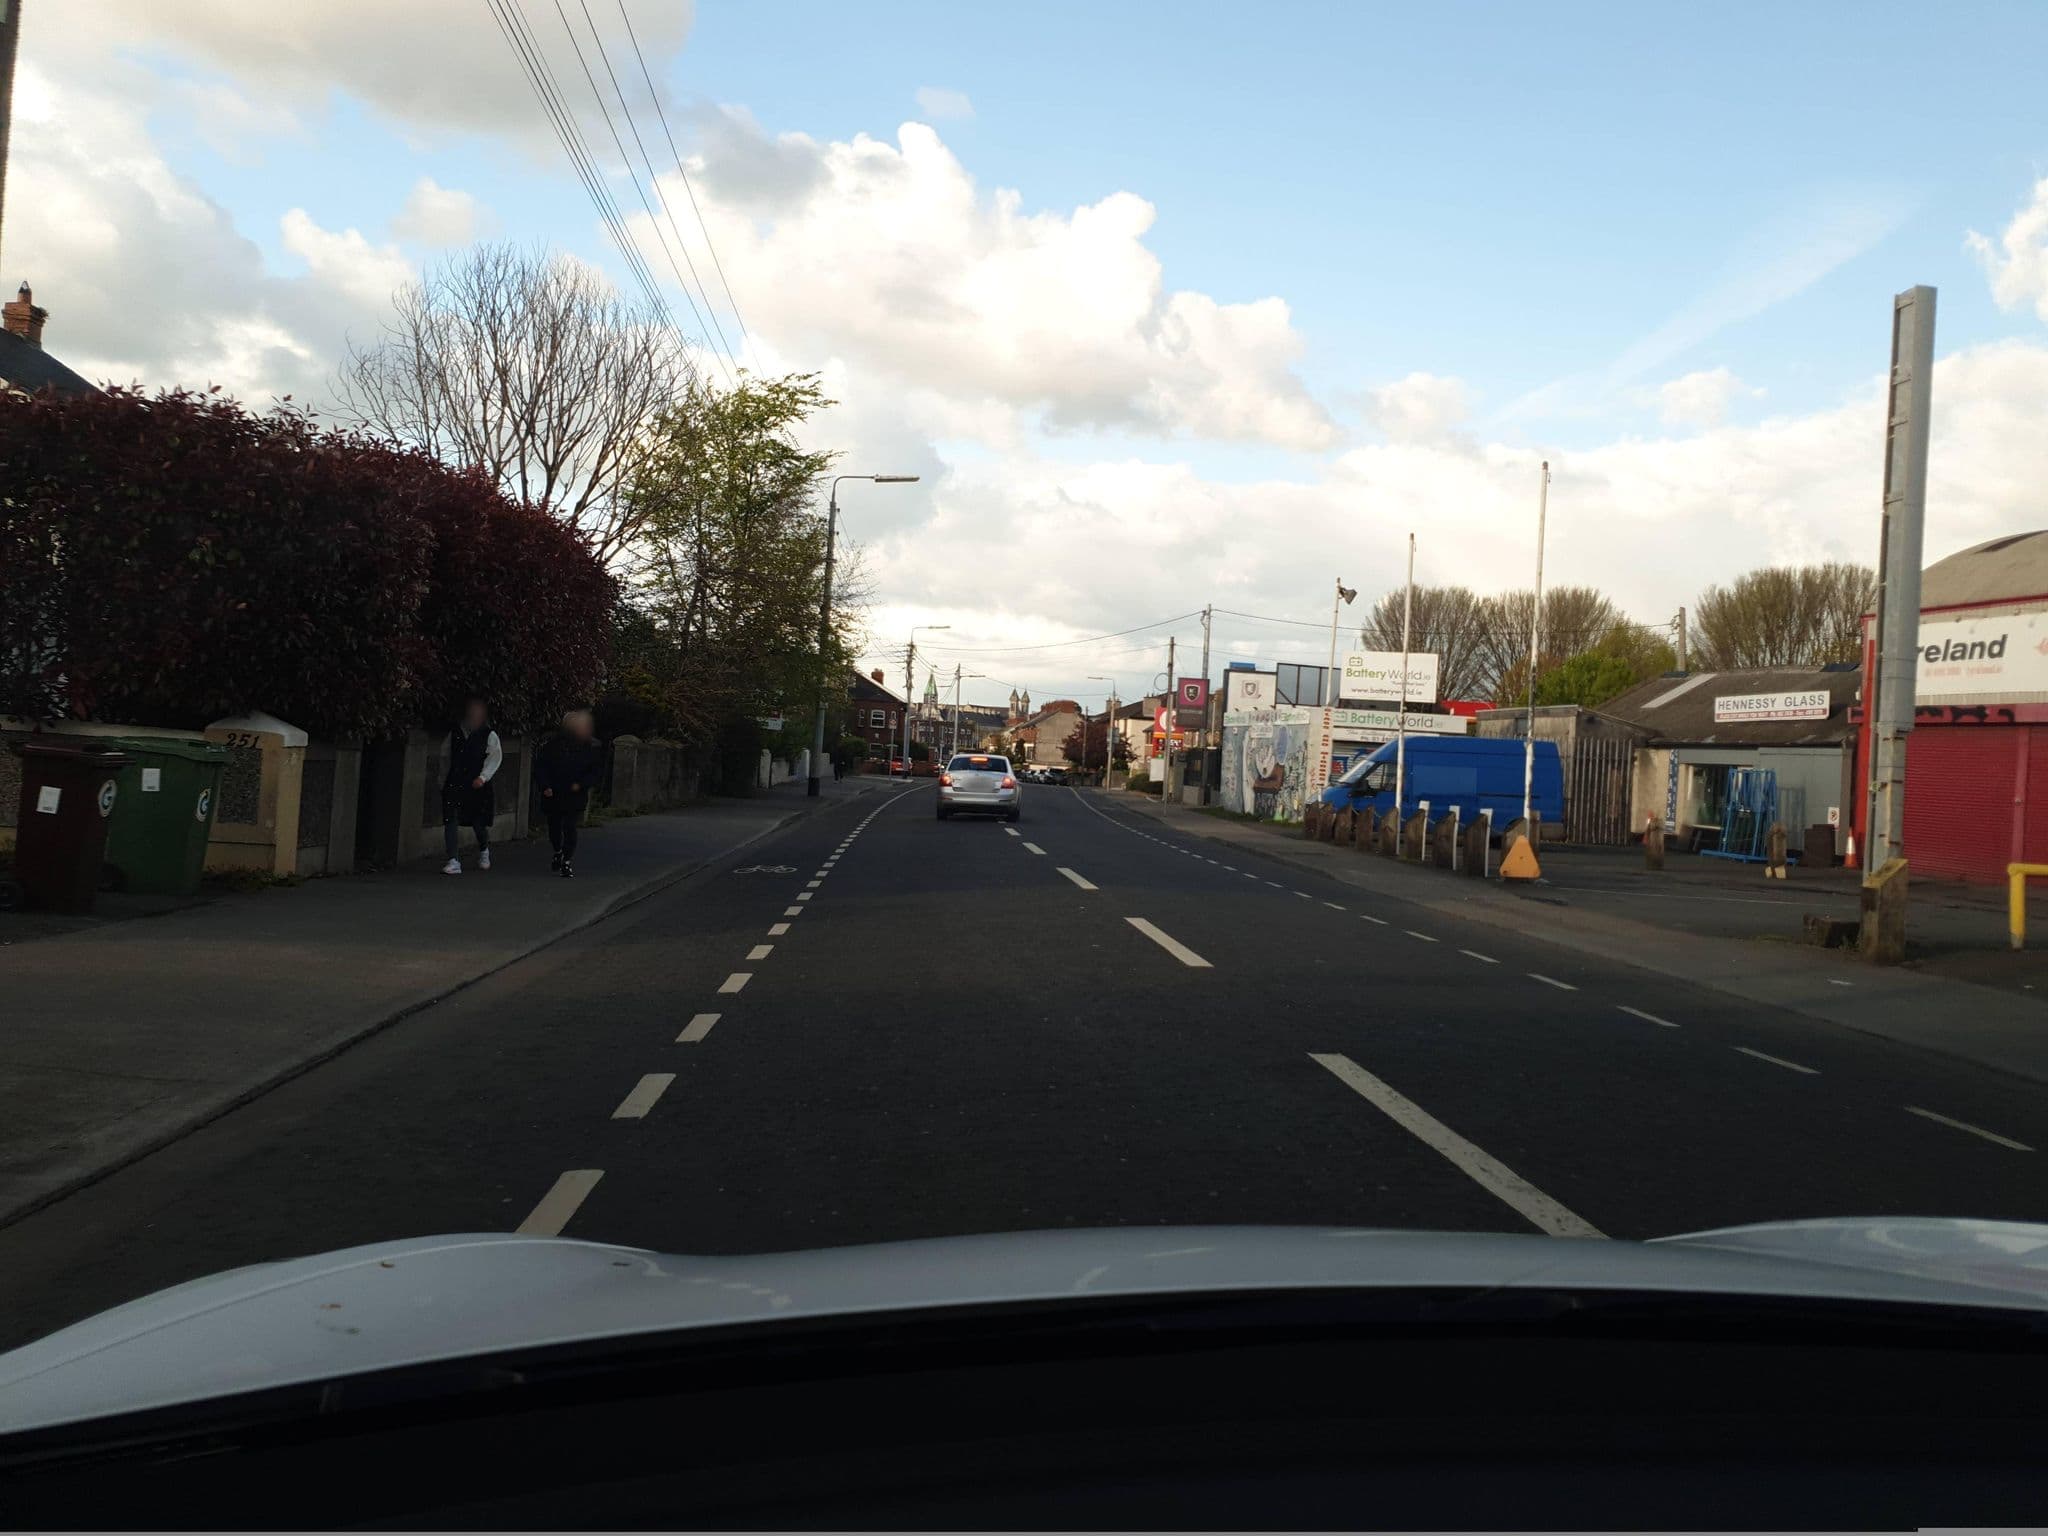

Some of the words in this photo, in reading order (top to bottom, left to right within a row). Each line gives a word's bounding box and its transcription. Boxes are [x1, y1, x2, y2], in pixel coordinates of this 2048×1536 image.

[1916, 634, 2008, 663] reland
[1719, 698, 1777, 711] HENNESSY
[1784, 694, 1826, 708] GLASS
[226, 732, 260, 749] 251
